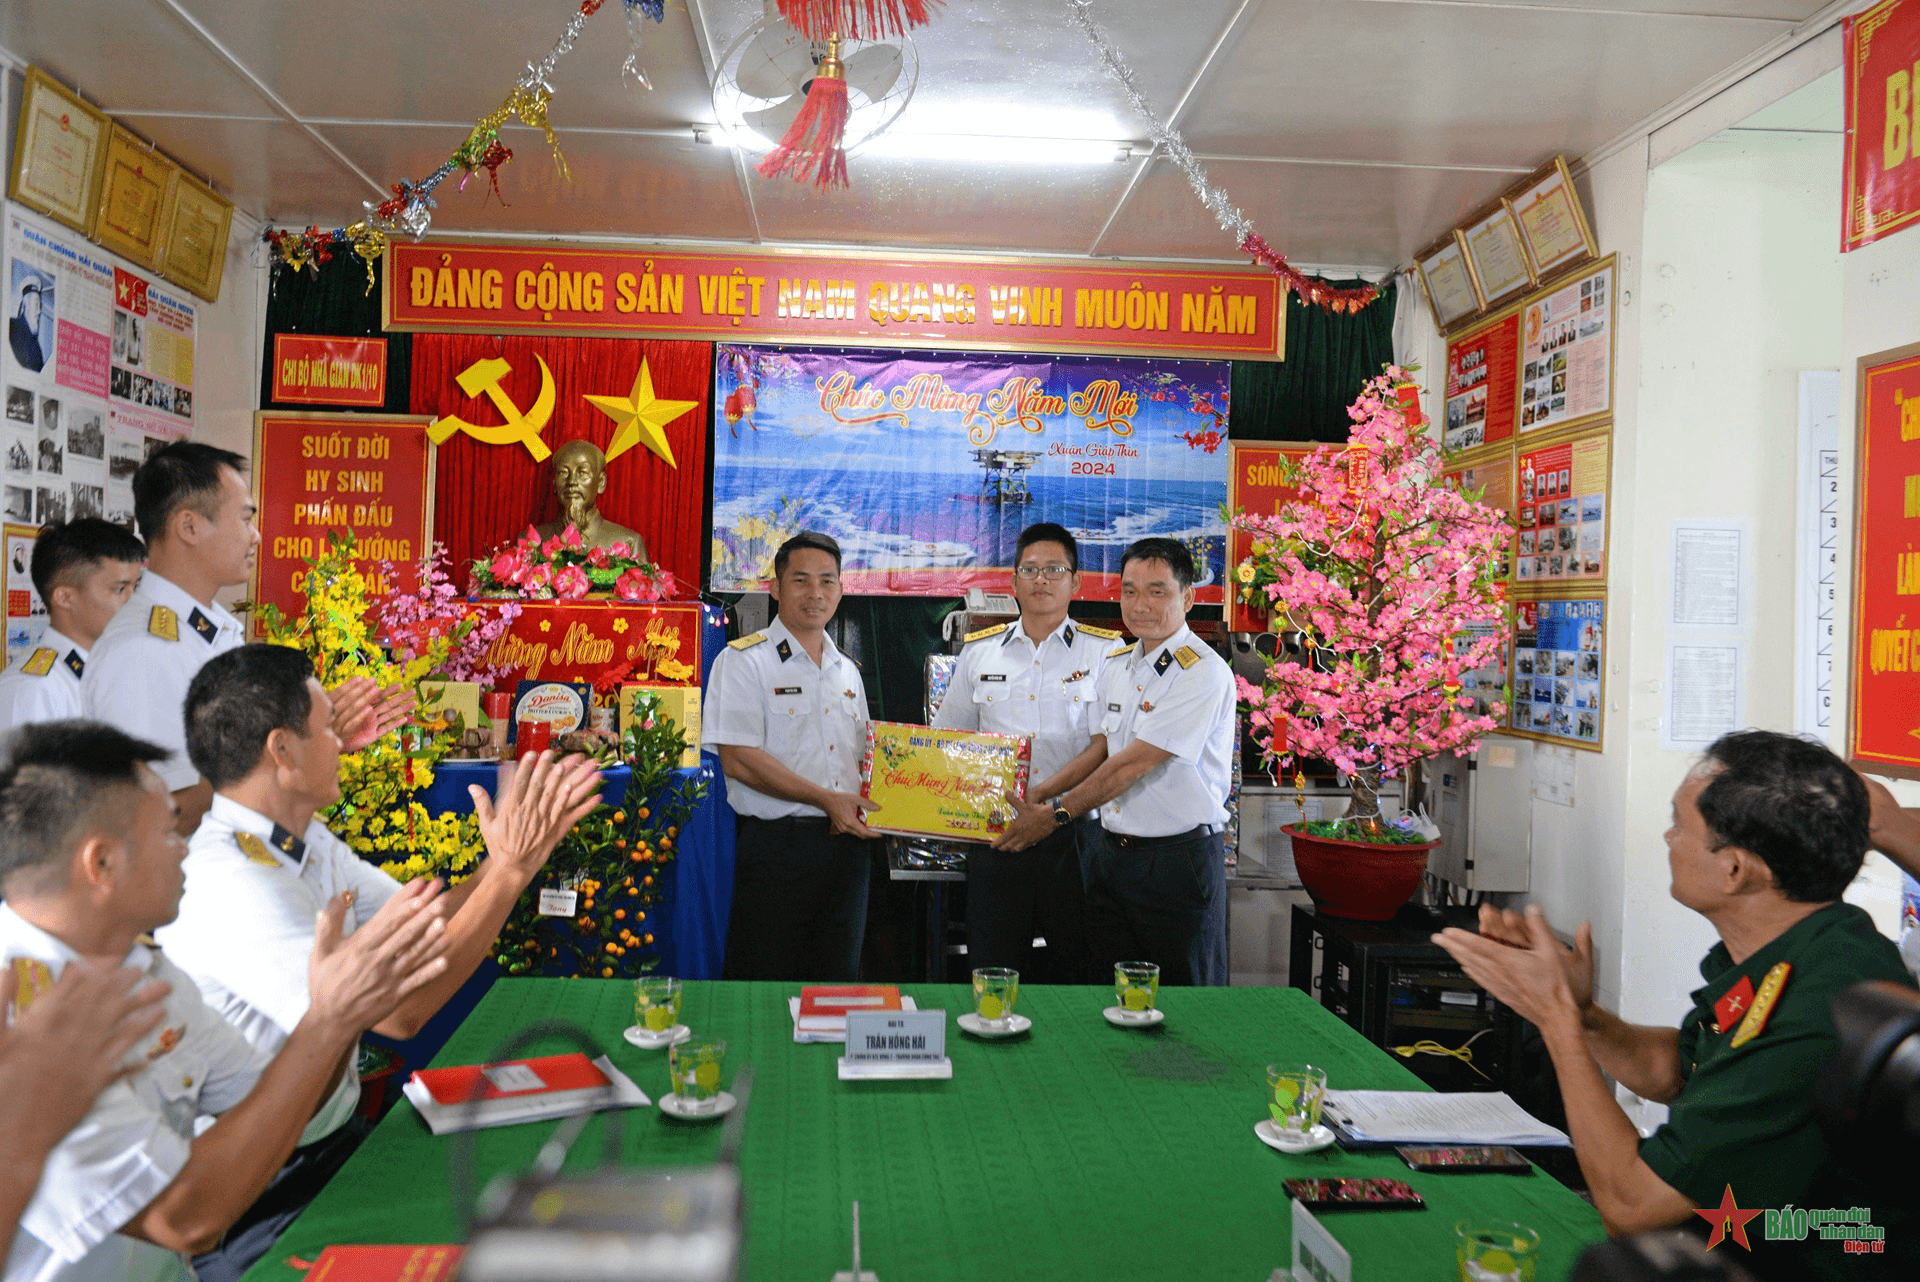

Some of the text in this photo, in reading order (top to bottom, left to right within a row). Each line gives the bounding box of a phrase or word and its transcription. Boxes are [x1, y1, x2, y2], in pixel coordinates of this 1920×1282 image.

[411, 253, 1257, 335] ĐẢNG CỘNG SẢN VIỆT NAM QUANG VINH MUÔN NĂM
[282, 358, 297, 386] CHI
[297, 353, 310, 394] BỘ
[310, 352, 328, 388] NHÀ
[329, 353, 349, 388] GIÀN
[815, 370, 1139, 446] Chúc Mừng Năm Mới
[302, 430, 390, 460] SUỐT ĐỜI
[1048, 441, 1137, 459] Xuân Giáp Thìn
[305, 469, 383, 493] HY SINH
[1071, 461, 1115, 476] 2024
[1830, 481, 1838, 492] 2
[294, 496, 393, 527] PHẤN ĐẤU
[1830, 517, 1837, 528] 3
[273, 536, 313, 560] CHO
[355, 531, 411, 562] ƯỞNG
[550, 621, 614, 666] Năm
[1870, 614, 1911, 676] QUYẾT
[529, 693, 571, 708] Danisa
[866, 1031, 926, 1049] TRẦN HỒNG HẢI
